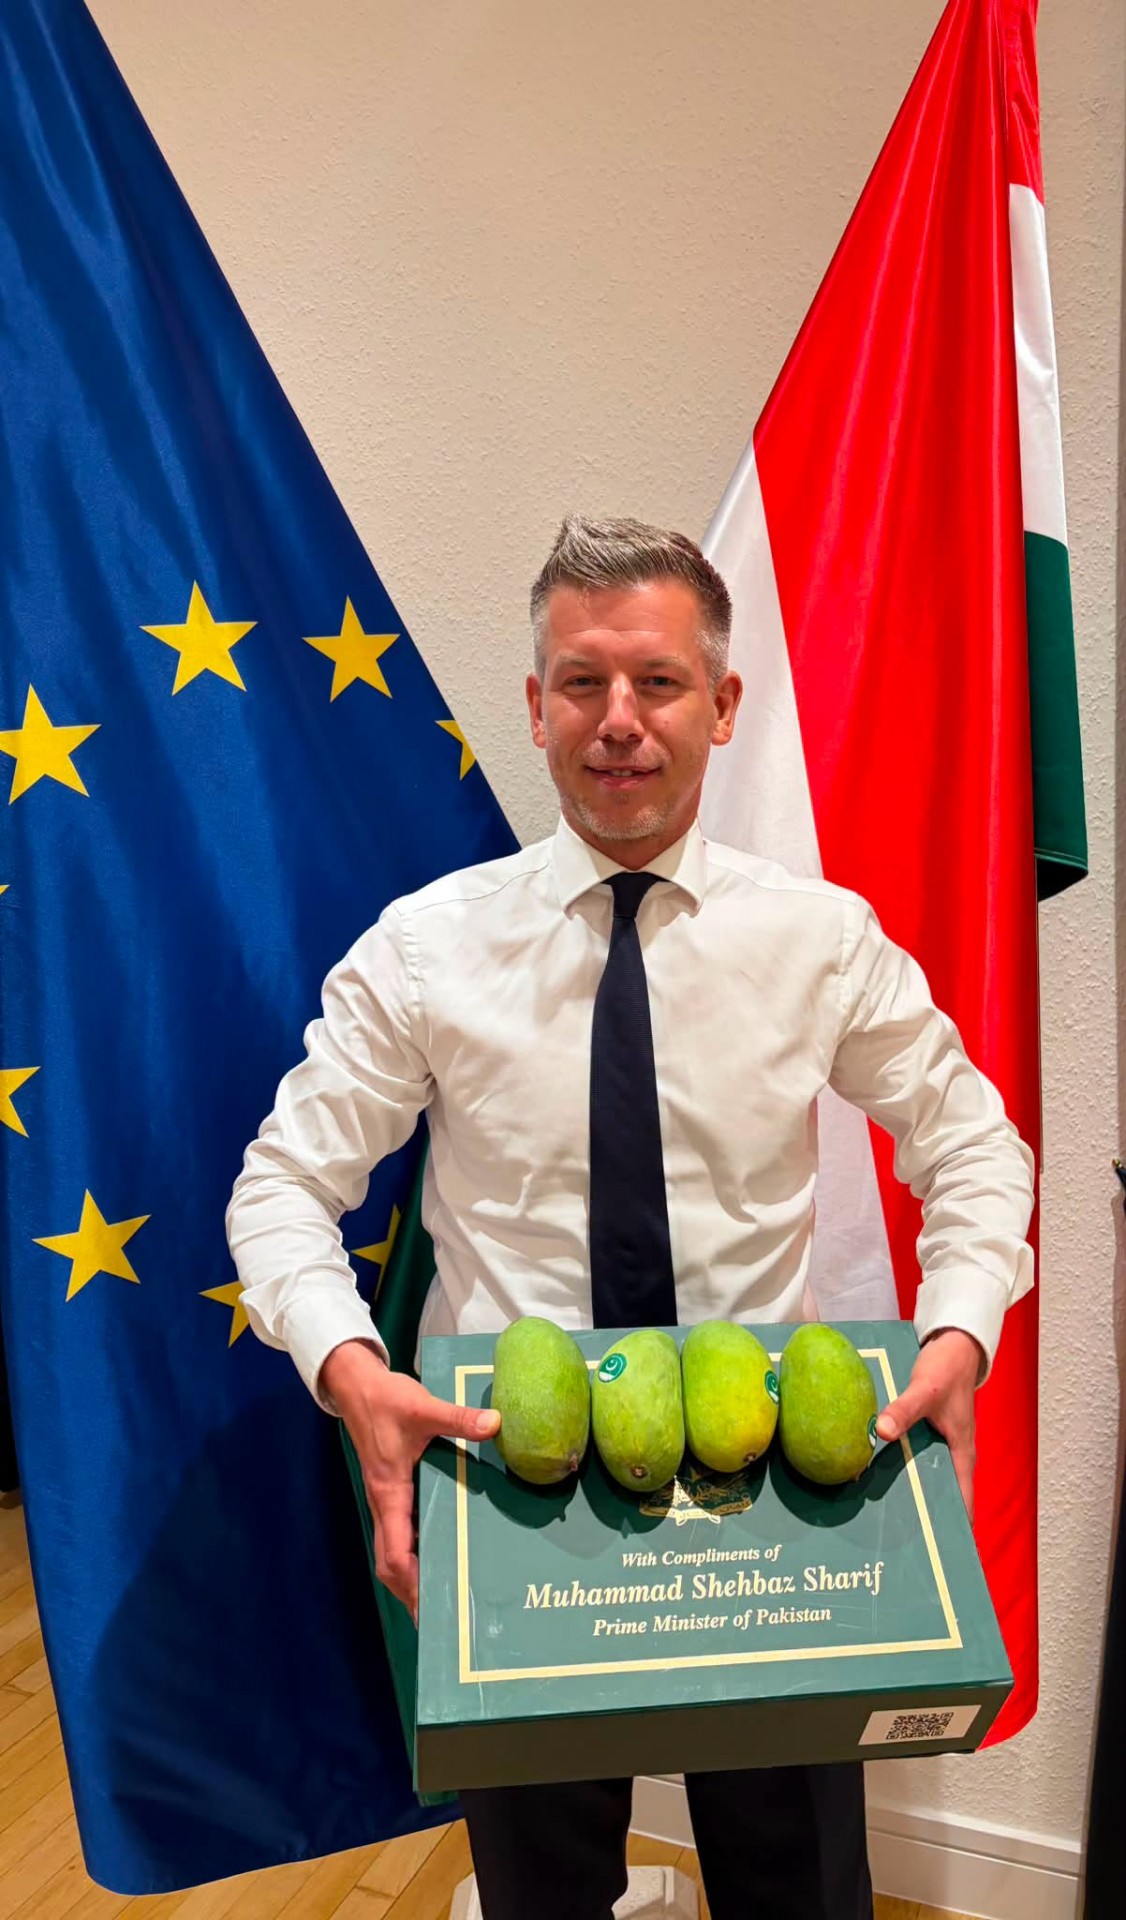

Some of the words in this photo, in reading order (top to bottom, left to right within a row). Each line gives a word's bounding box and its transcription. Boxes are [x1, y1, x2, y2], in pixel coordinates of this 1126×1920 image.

[622, 1551, 657, 1568] With
[661, 1547, 760, 1568] Compliments
[764, 1544, 782, 1561] of
[523, 1574, 684, 1609] Muhammad
[692, 1570, 796, 1600] Shehbaz
[803, 1561, 885, 1596] Sharif
[592, 1618, 648, 1637] Prime
[652, 1613, 729, 1633] Minister
[733, 1609, 753, 1630] of
[756, 1607, 832, 1626] Pakistan
